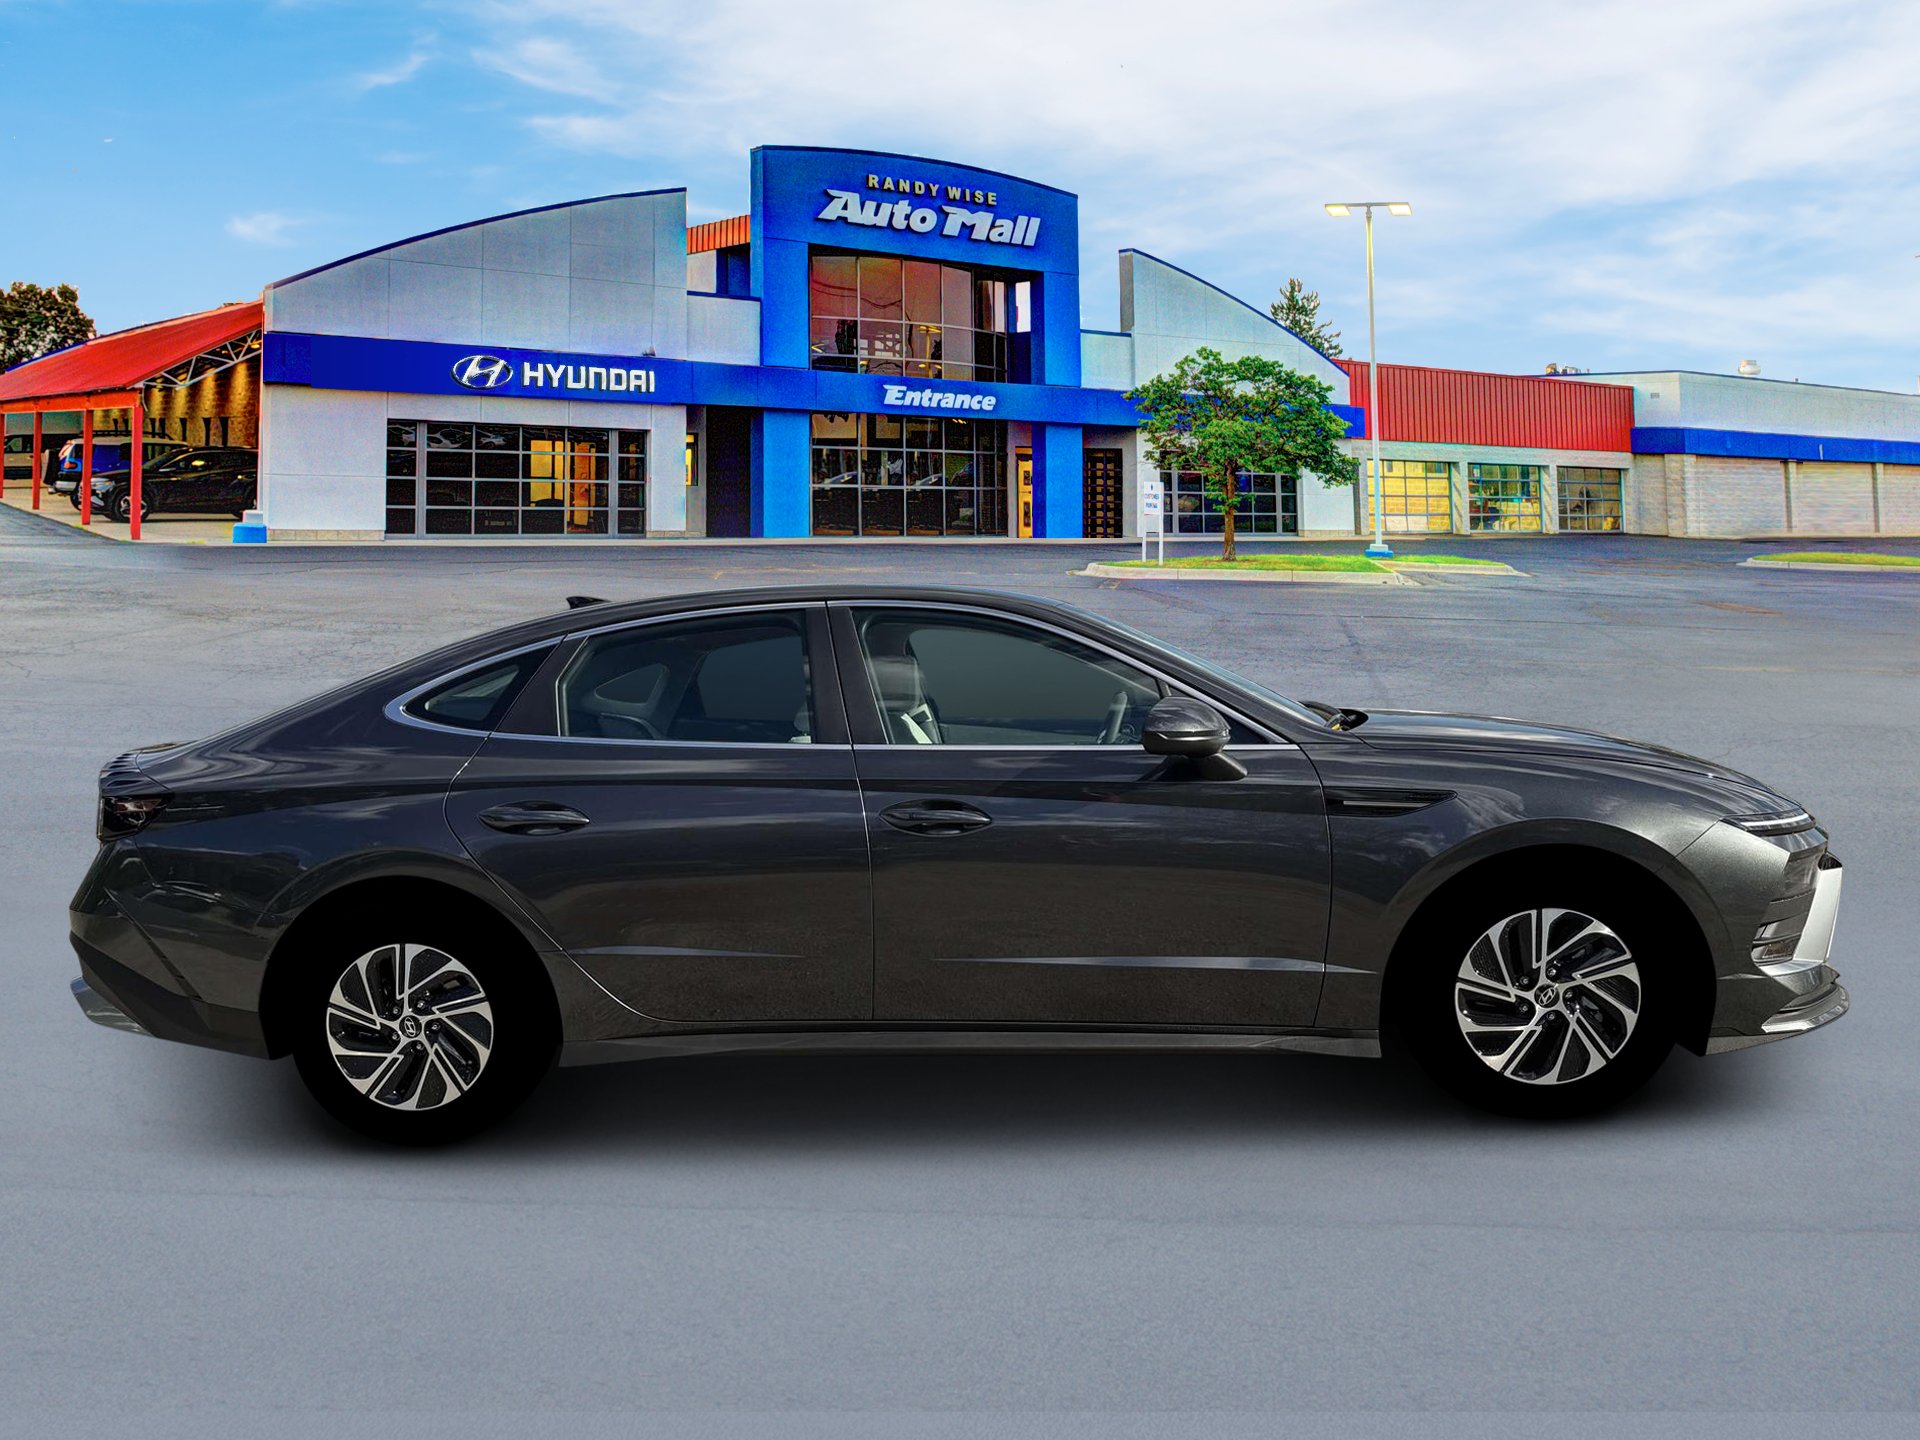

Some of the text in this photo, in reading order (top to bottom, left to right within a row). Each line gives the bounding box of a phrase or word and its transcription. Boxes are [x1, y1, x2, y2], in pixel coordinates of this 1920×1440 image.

[867, 173, 997, 206] RANDY WISE
[817, 188, 1041, 247] Auto Mall
[522, 361, 656, 393] HYUNDAI
[882, 384, 997, 411] Entrance
